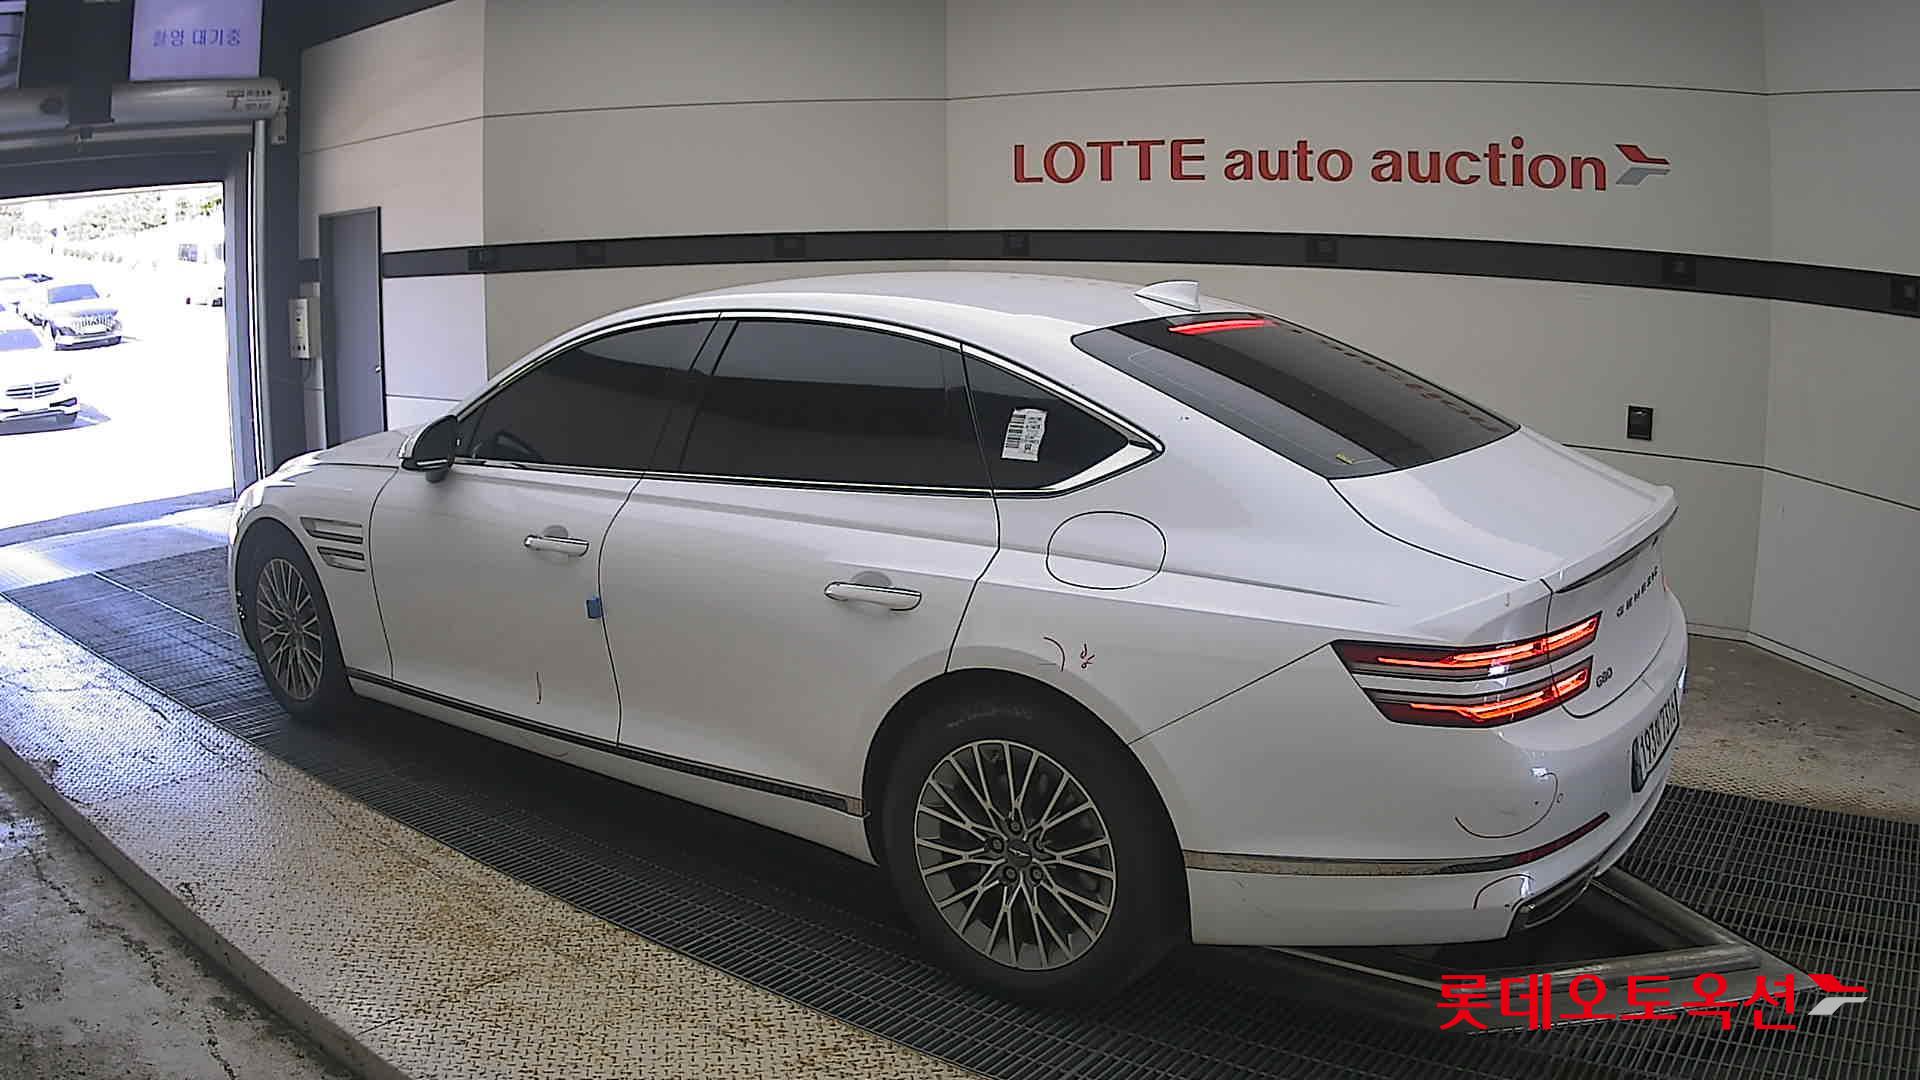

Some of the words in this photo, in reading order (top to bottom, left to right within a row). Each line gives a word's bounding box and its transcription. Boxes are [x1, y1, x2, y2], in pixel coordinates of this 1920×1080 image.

[192, 28, 241, 46] 대기중
[1014, 140, 1206, 184] LOTTE
[1225, 141, 1352, 182] auto
[1371, 137, 1607, 191] auction
[1595, 667, 1614, 688] G80
